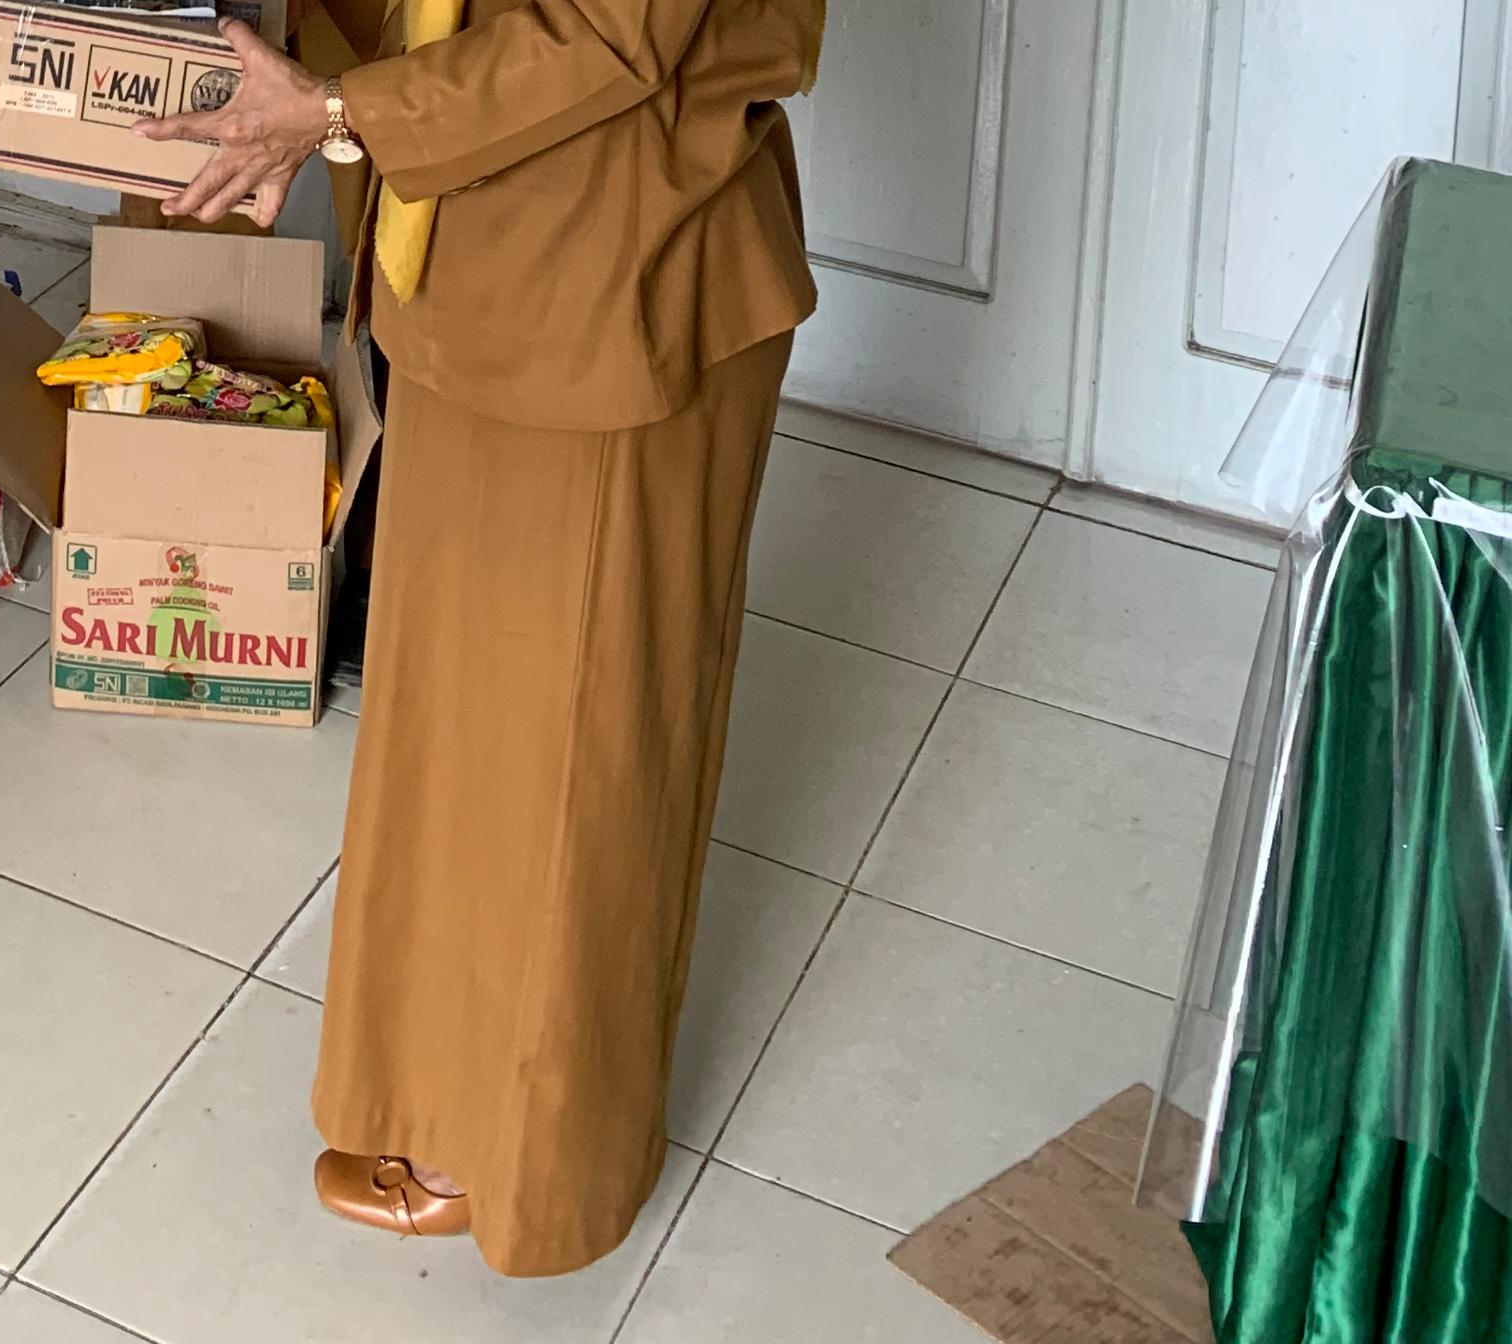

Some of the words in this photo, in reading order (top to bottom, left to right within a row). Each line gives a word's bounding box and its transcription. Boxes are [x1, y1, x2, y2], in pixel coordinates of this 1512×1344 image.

[8, 42, 76, 91] SNI
[107, 69, 161, 108] KAN
[139, 577, 170, 588] MINYAK
[209, 583, 234, 596] SAWIT
[151, 596, 170, 606] PALM
[171, 596, 207, 608] COOKING
[61, 607, 158, 657] SARI
[170, 617, 308, 668] MURNI
[94, 674, 121, 692] SNI
[220, 685, 263, 696] KEMASAN
[220, 695, 248, 704] NETTO
